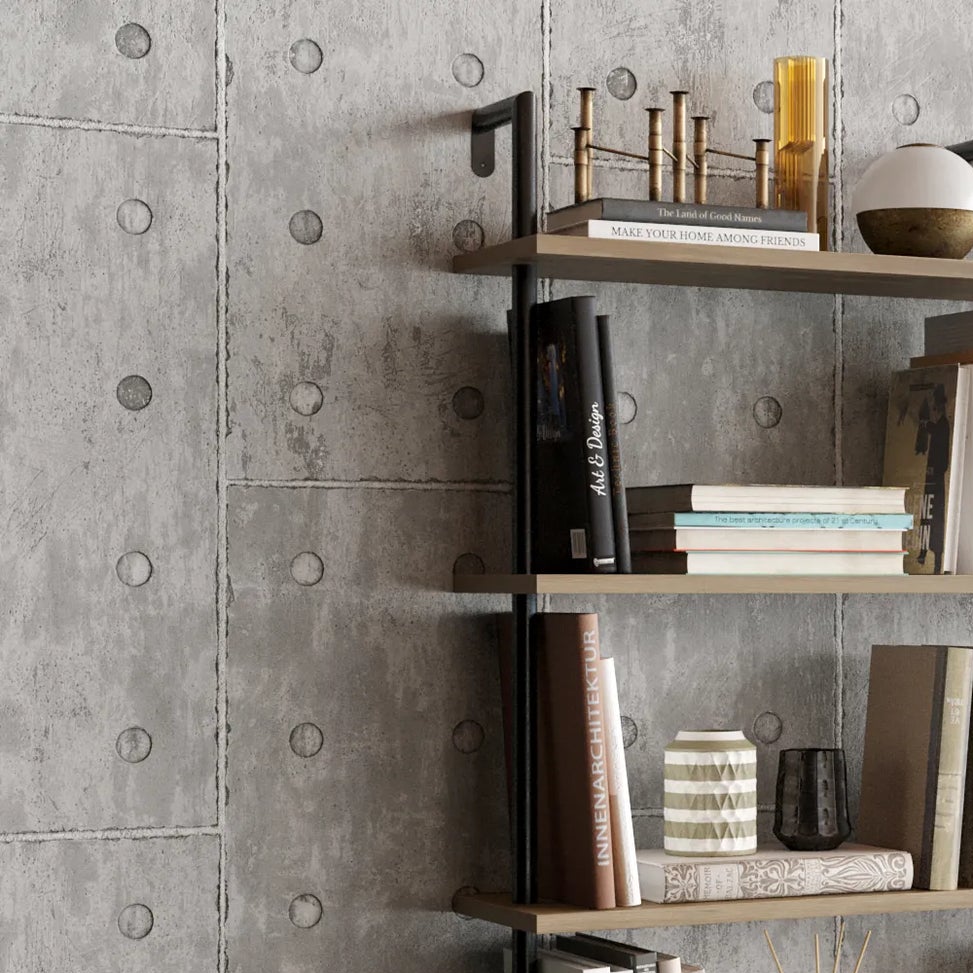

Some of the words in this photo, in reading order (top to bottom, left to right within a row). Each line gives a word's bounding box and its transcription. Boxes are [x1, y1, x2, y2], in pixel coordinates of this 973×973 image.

[657, 207, 674, 218] The
[675, 208, 698, 219] Land
[699, 209, 708, 220] of
[709, 210, 733, 222] Good
[734, 212, 763, 224] Names
[611, 226, 643, 239] MAKE
[645, 227, 678, 240] YOUR
[680, 229, 714, 242] HOME
[716, 231, 758, 245] AMONG
[761, 233, 806, 248] FRIENDS
[585, 401, 604, 449] Design
[587, 453, 605, 467] &
[590, 470, 608, 496] Art
[715, 515, 728, 524] The
[730, 515, 746, 524] best
[748, 515, 791, 525] architecture
[583, 629, 610, 867] INNENARCHITEKTUR
